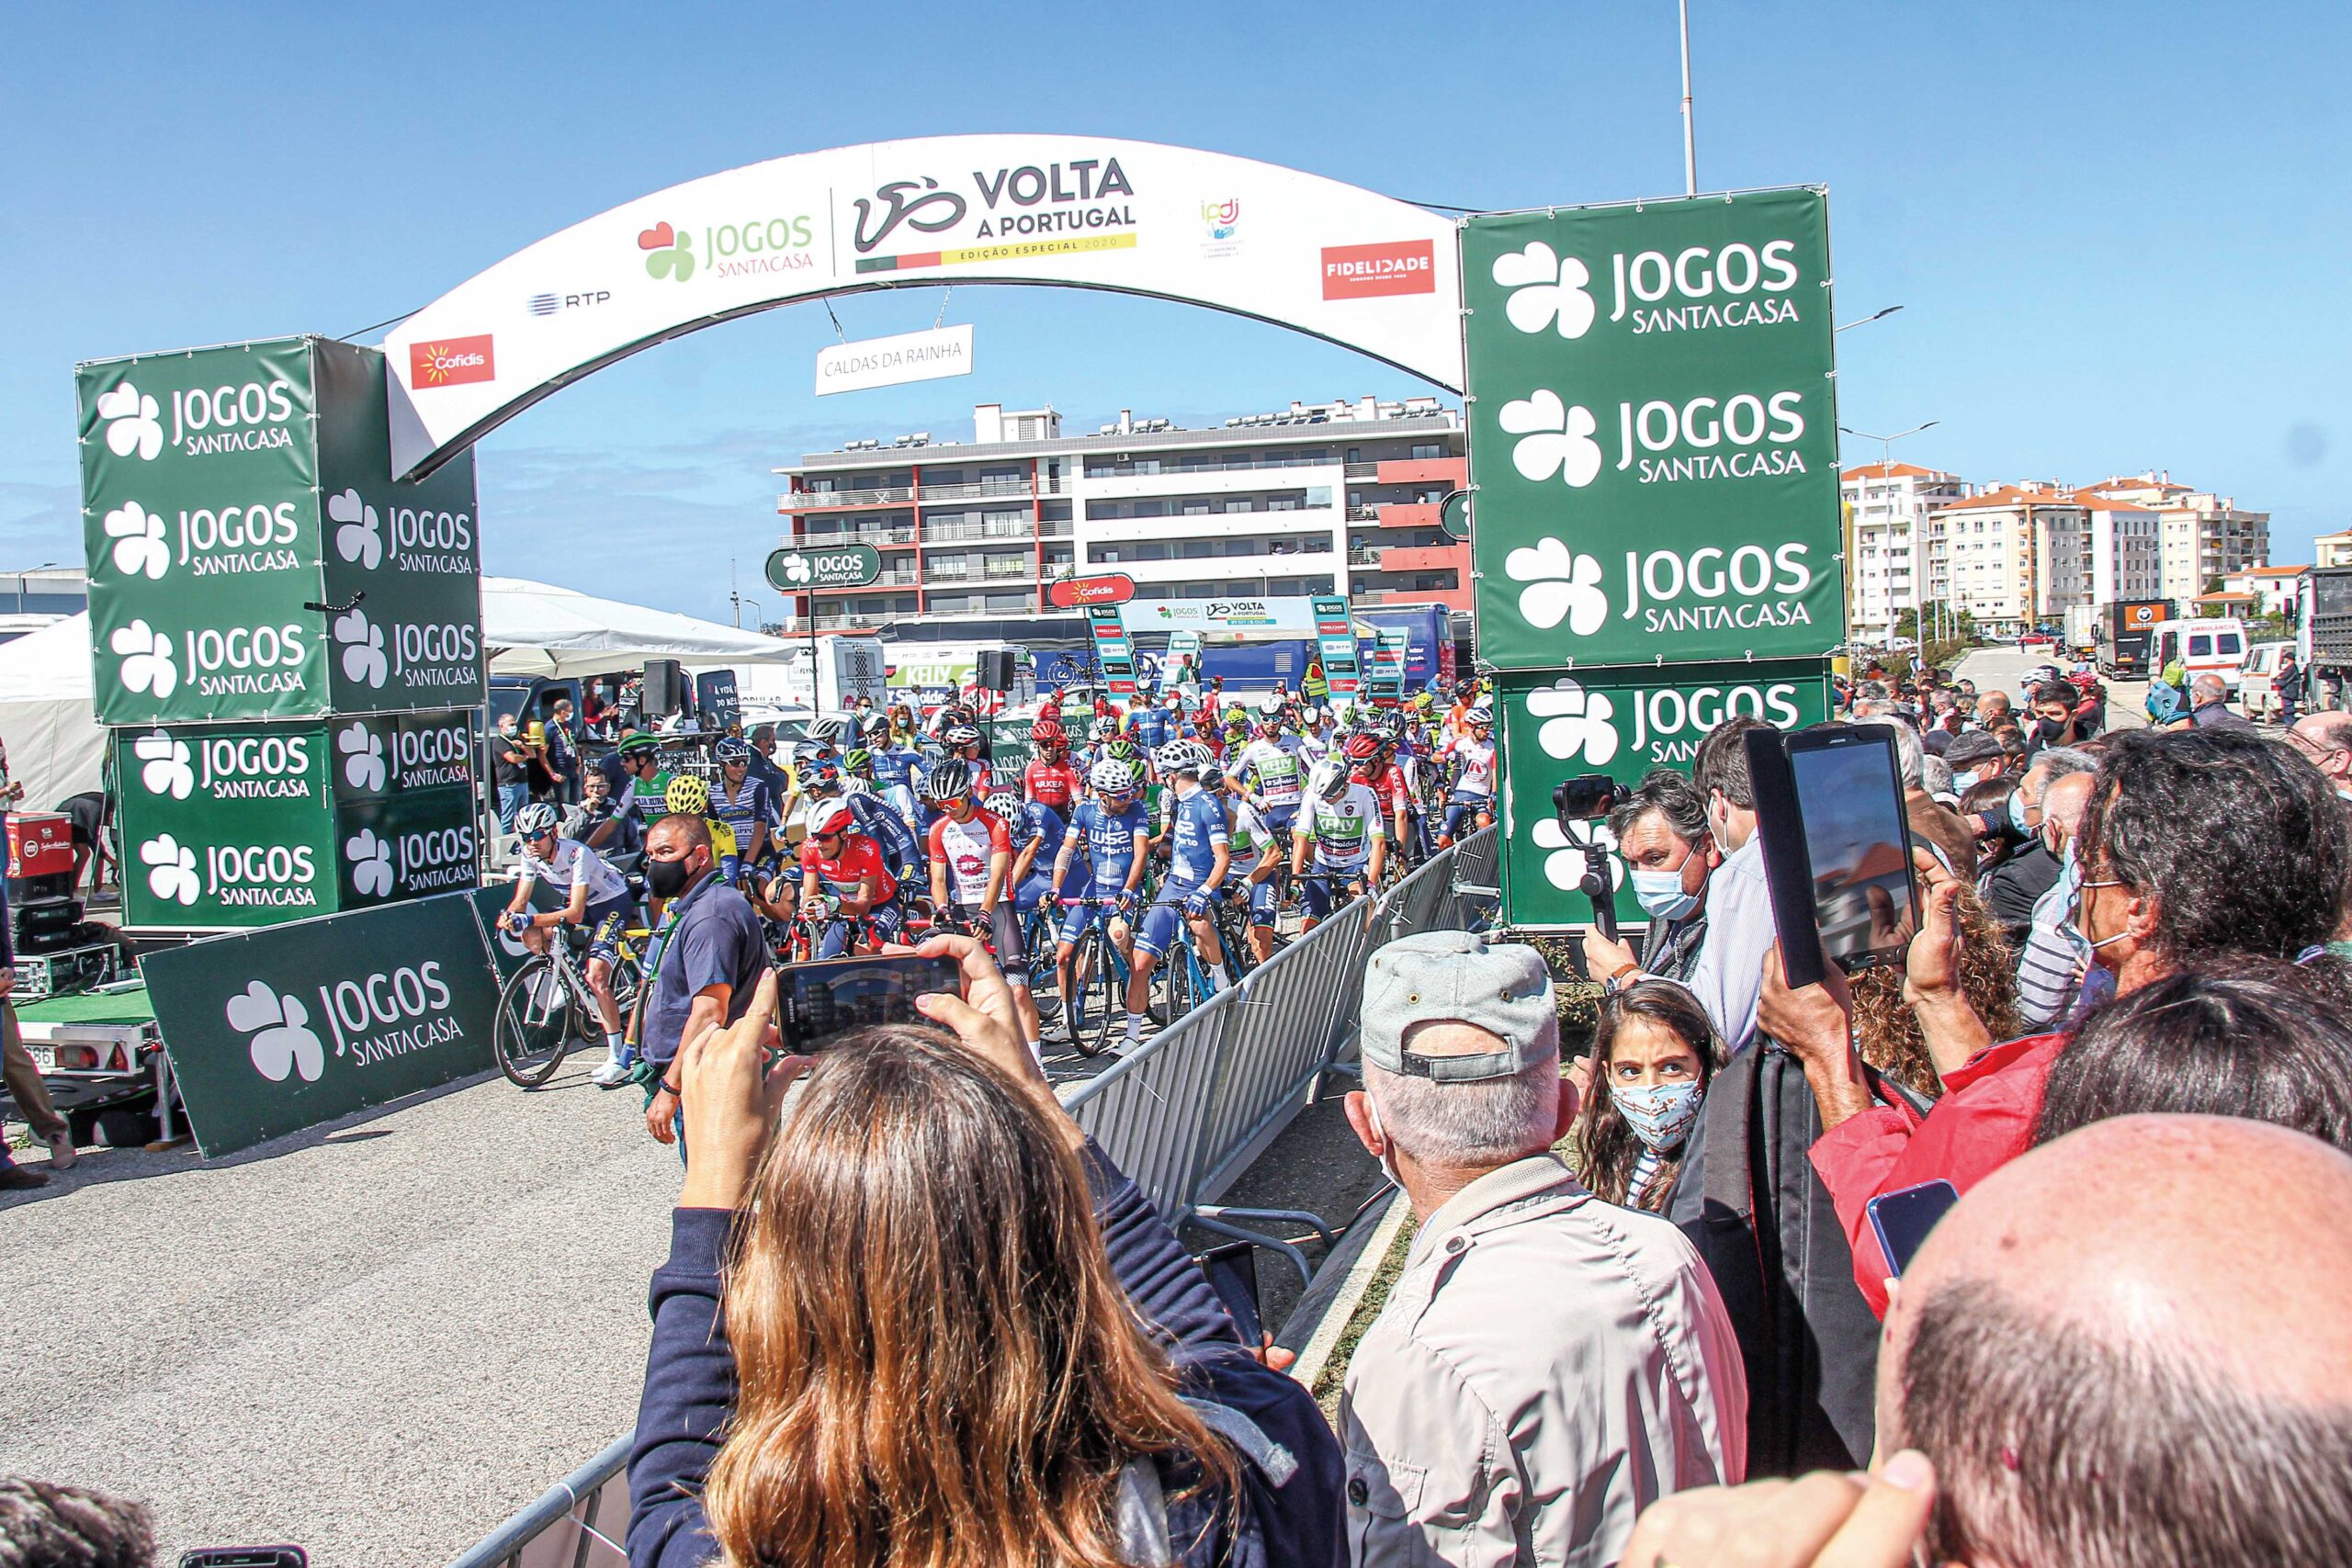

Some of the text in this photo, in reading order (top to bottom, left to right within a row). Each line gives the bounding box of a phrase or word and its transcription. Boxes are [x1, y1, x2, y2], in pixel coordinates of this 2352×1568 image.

[972, 156, 1135, 209] VOLTA
[977, 205, 1136, 239] A PORTUGAL
[705, 214, 813, 270] JOGOS
[960, 247, 1009, 261] EDIÇÃO
[1015, 242, 1078, 254] ESPECIAL
[717, 254, 814, 279] SANTACASA
[1327, 256, 1430, 277] FIDELIDADE
[1610, 240, 1798, 323] JOGOS
[566, 290, 611, 308] RTP
[1632, 299, 1800, 335] SANTACASA
[435, 351, 485, 371] Cofidis
[824, 341, 963, 378] CALDAS DA RAINHA
[172, 380, 293, 446] JOGOS
[187, 427, 294, 457] SANTACASA
[1616, 390, 1805, 472] JOGOS
[1638, 450, 1807, 484] SANTACASA
[178, 502, 299, 566] JOGOS
[389, 506, 472, 560] JOGOS
[193, 548, 300, 577] SANTACASA
[399, 552, 473, 574] SANTACASA
[813, 553, 864, 579] JOGOS
[1080, 586, 1114, 597] Cofidis
[1623, 542, 1813, 621] JOGOS
[1173, 607, 1198, 616] JOGOS
[1230, 602, 1265, 611] VOLTA
[1645, 601, 1813, 633] SANTACASA
[186, 623, 306, 686] JOGOS
[394, 623, 477, 676] JOGOS
[199, 670, 307, 697] SANTACASA
[405, 667, 478, 687] SANTACASA
[906, 665, 953, 685] KELLY
[1631, 682, 1800, 752] JOGOS
[200, 736, 310, 789] JOGOS
[390, 727, 469, 780] JOGOS
[213, 779, 311, 799] SANTACASA
[401, 766, 469, 788] SANTACASA
[1035, 780, 1065, 788] ARKEA
[721, 810, 750, 818] DELKO
[399, 826, 473, 884] JOGOS
[1102, 846, 1133, 855] Porto
[207, 845, 316, 896] JOGOS
[409, 864, 475, 892] SANTACASA
[220, 886, 317, 908] SANTACASA
[319, 961, 452, 1057] JOGOS
[351, 1016, 464, 1067] SANTACASA
